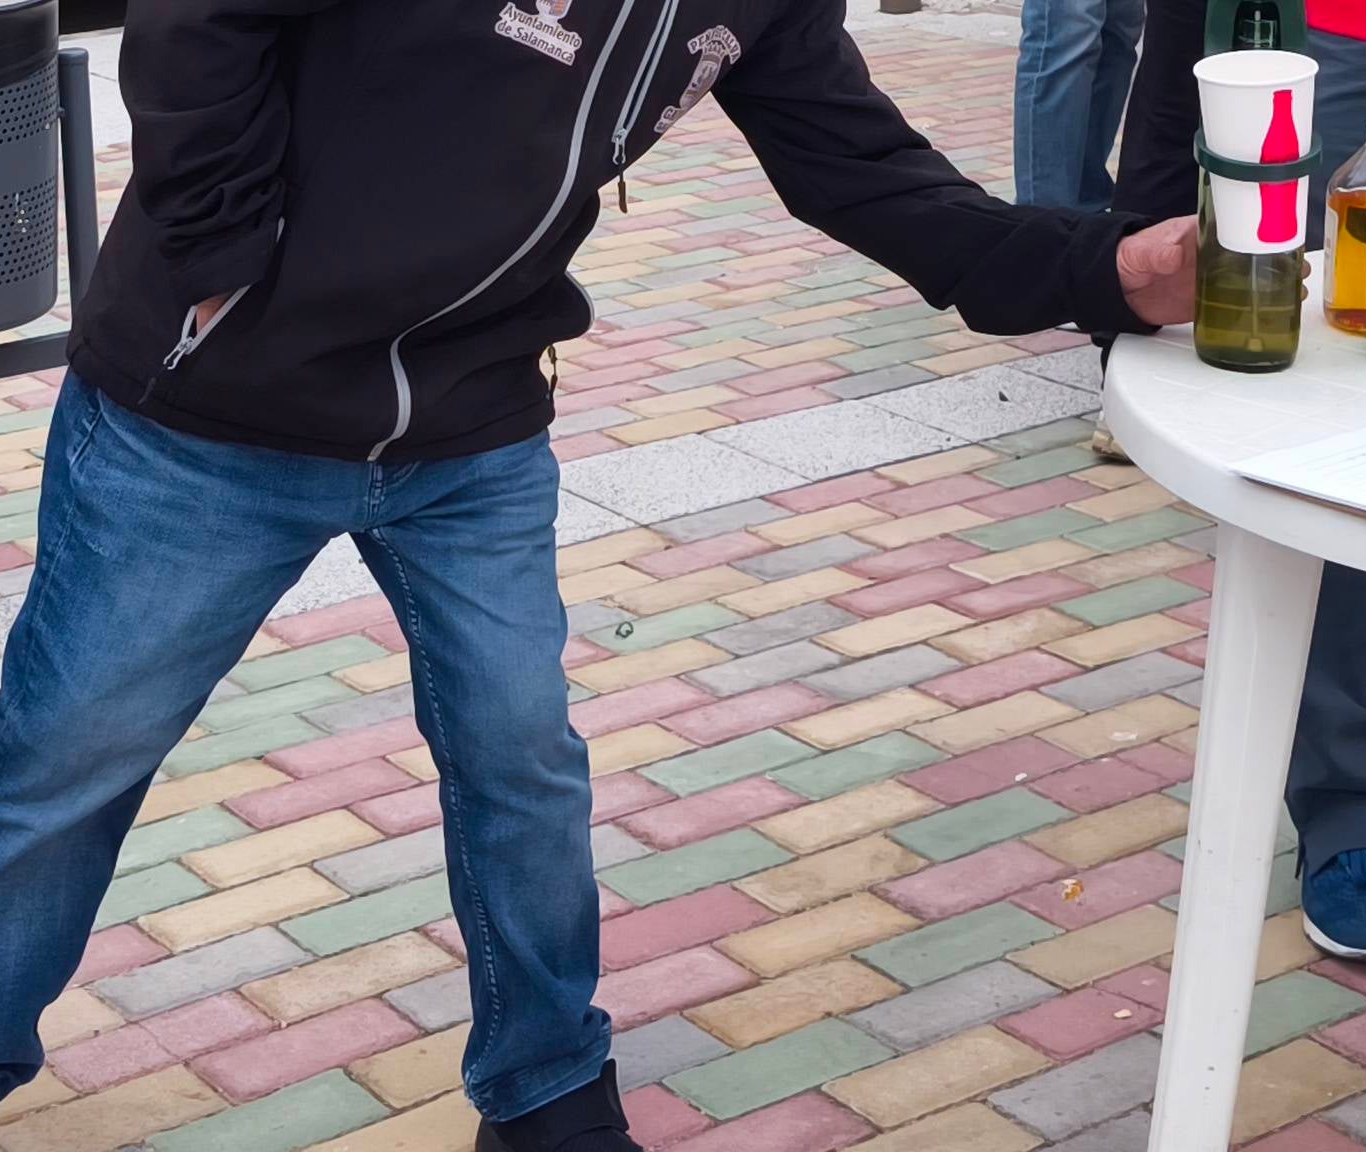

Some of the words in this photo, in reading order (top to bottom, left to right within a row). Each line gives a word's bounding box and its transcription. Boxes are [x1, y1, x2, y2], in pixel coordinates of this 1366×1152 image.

[497, 21, 512, 35] de
[514, 26, 574, 63] Salamanca
[502, 4, 582, 48] Ayuntamiento
